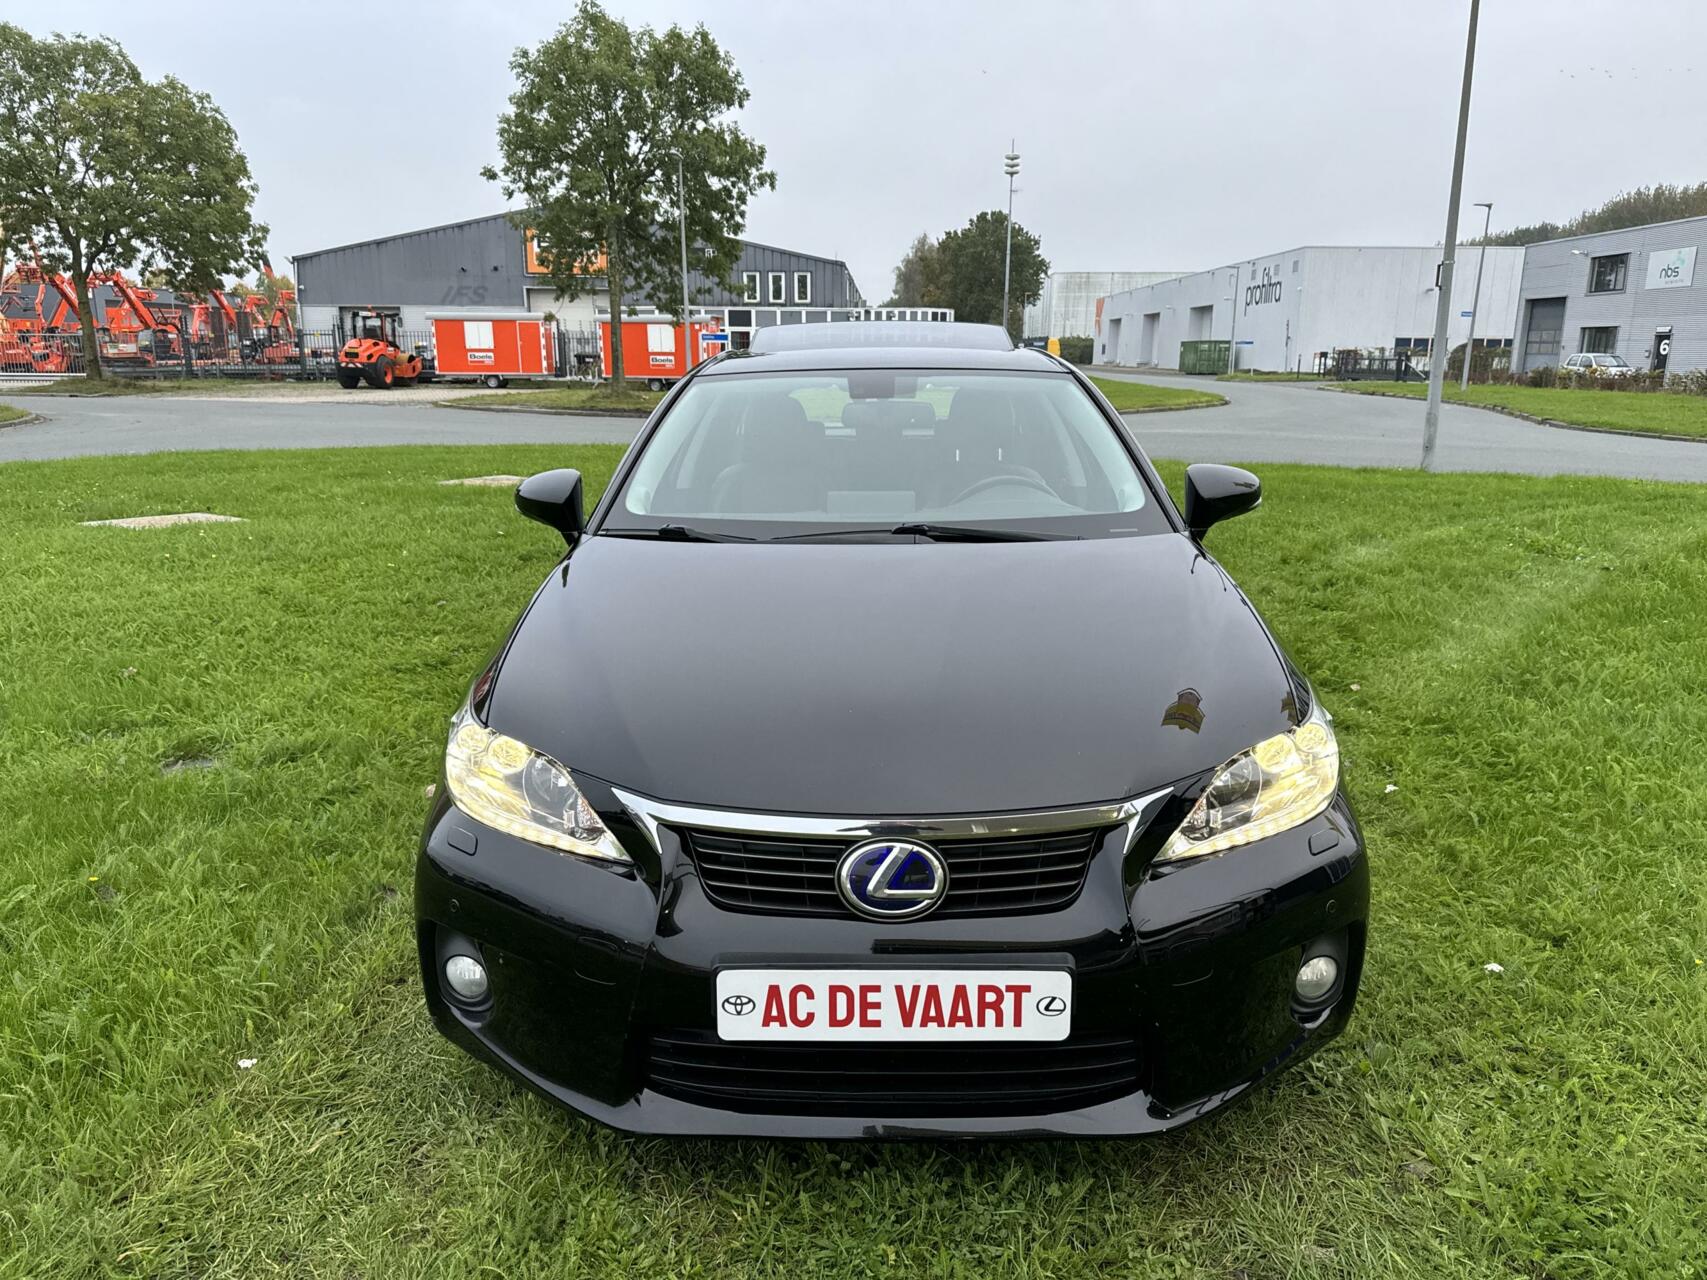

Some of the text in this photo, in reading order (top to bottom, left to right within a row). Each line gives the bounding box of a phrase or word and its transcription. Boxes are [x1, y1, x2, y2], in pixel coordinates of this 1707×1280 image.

[1659, 263, 1680, 279] nbs
[1244, 266, 1282, 317] profiltra
[1659, 339, 1670, 355] 6
[761, 984, 1032, 1028] AC DE VAART
